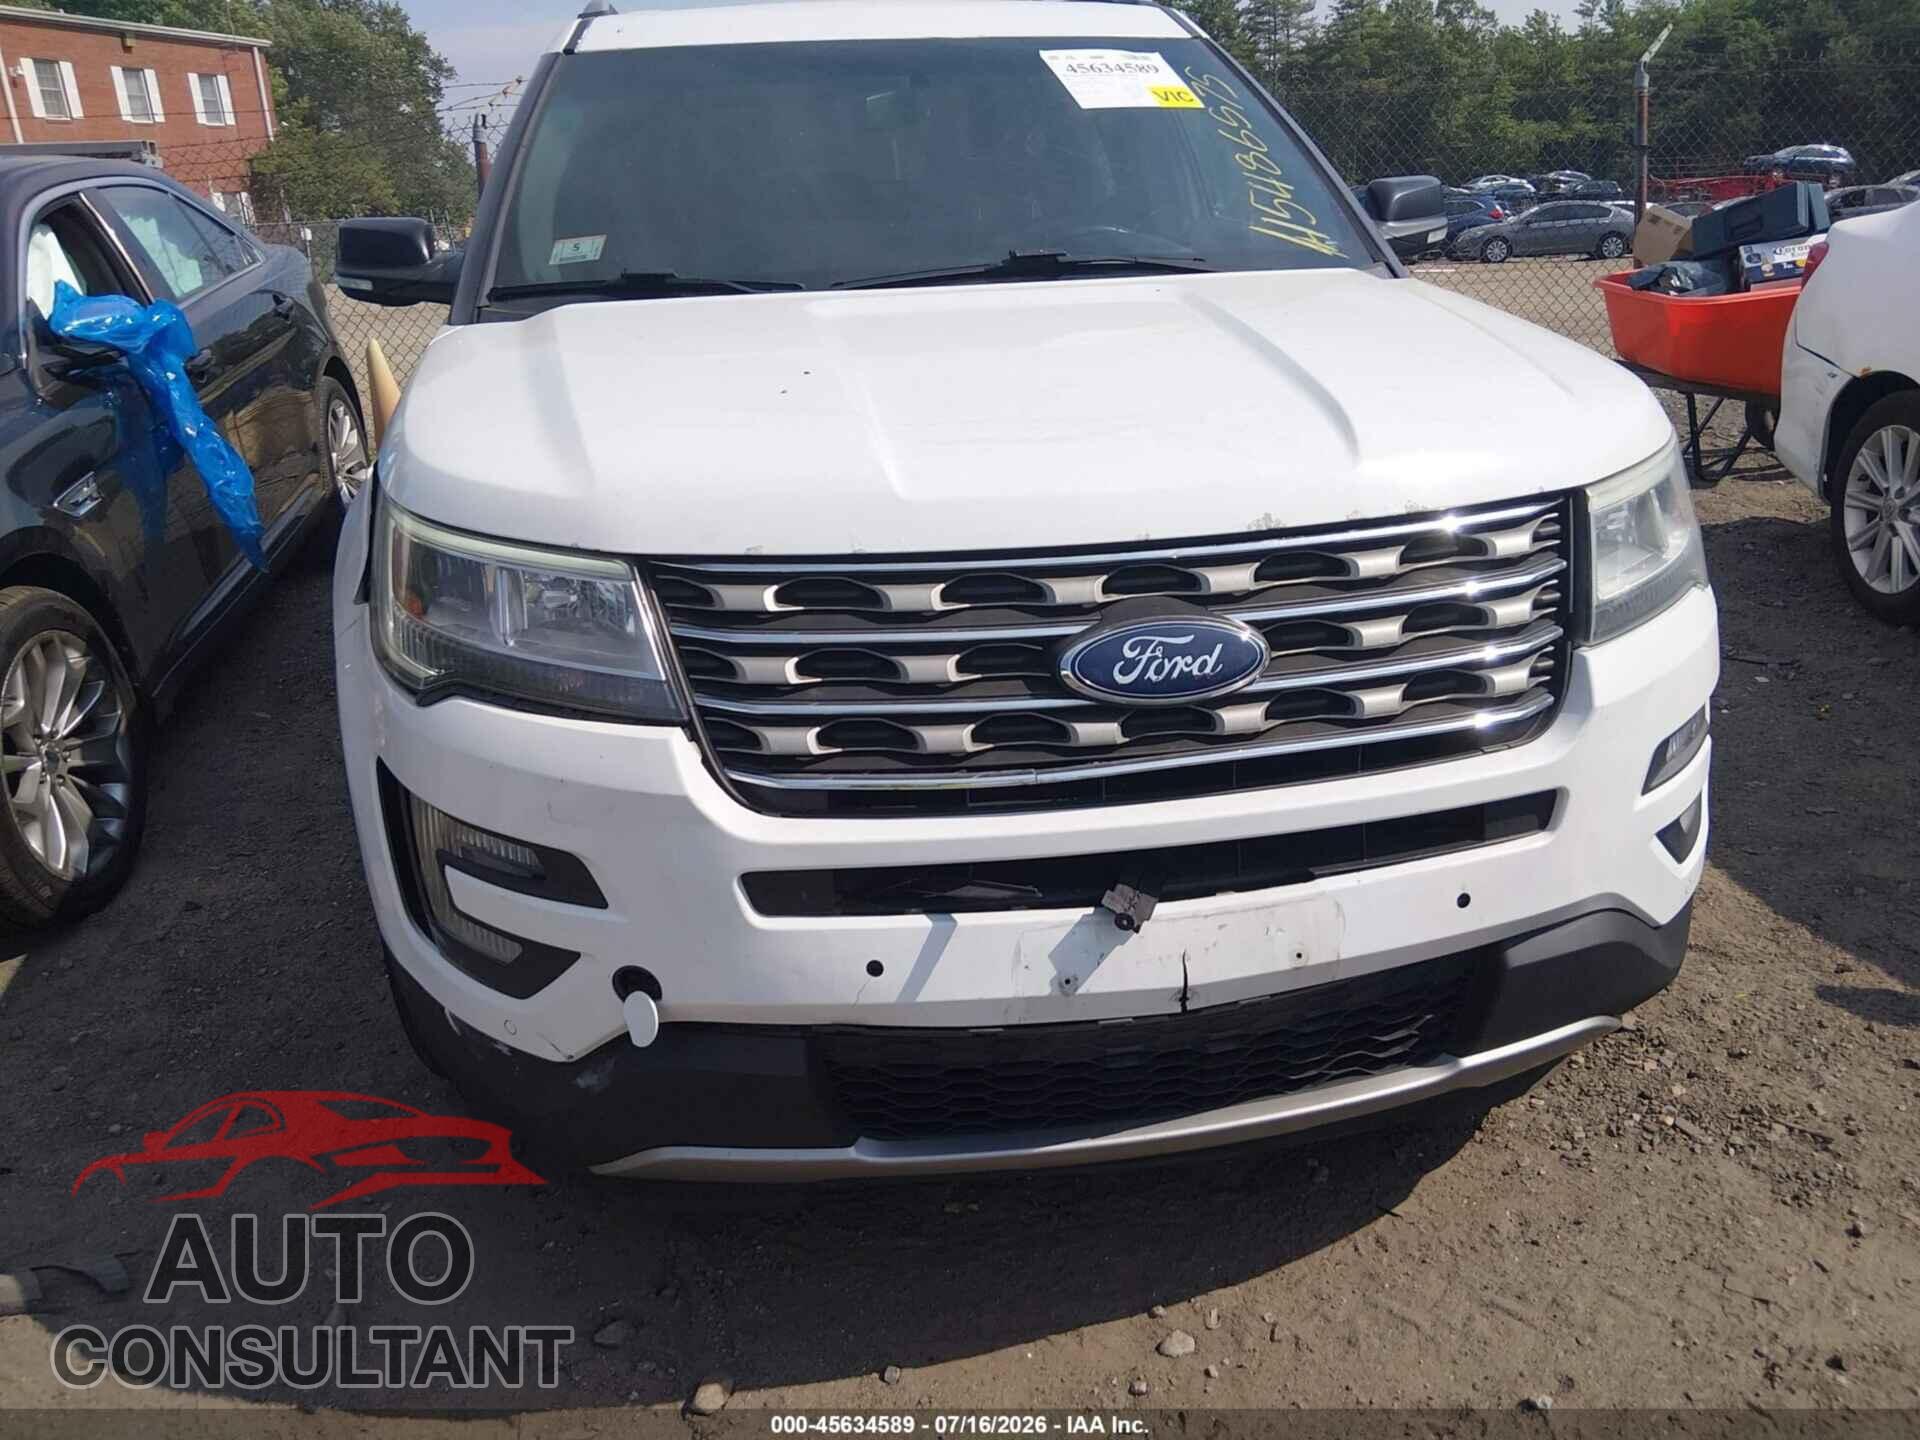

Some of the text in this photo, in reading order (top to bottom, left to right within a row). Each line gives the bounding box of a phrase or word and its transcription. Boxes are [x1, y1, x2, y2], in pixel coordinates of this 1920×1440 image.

[1065, 62, 1160, 75] 45634589
[1151, 89, 1195, 103] VIC
[1113, 634, 1223, 685] Ford
